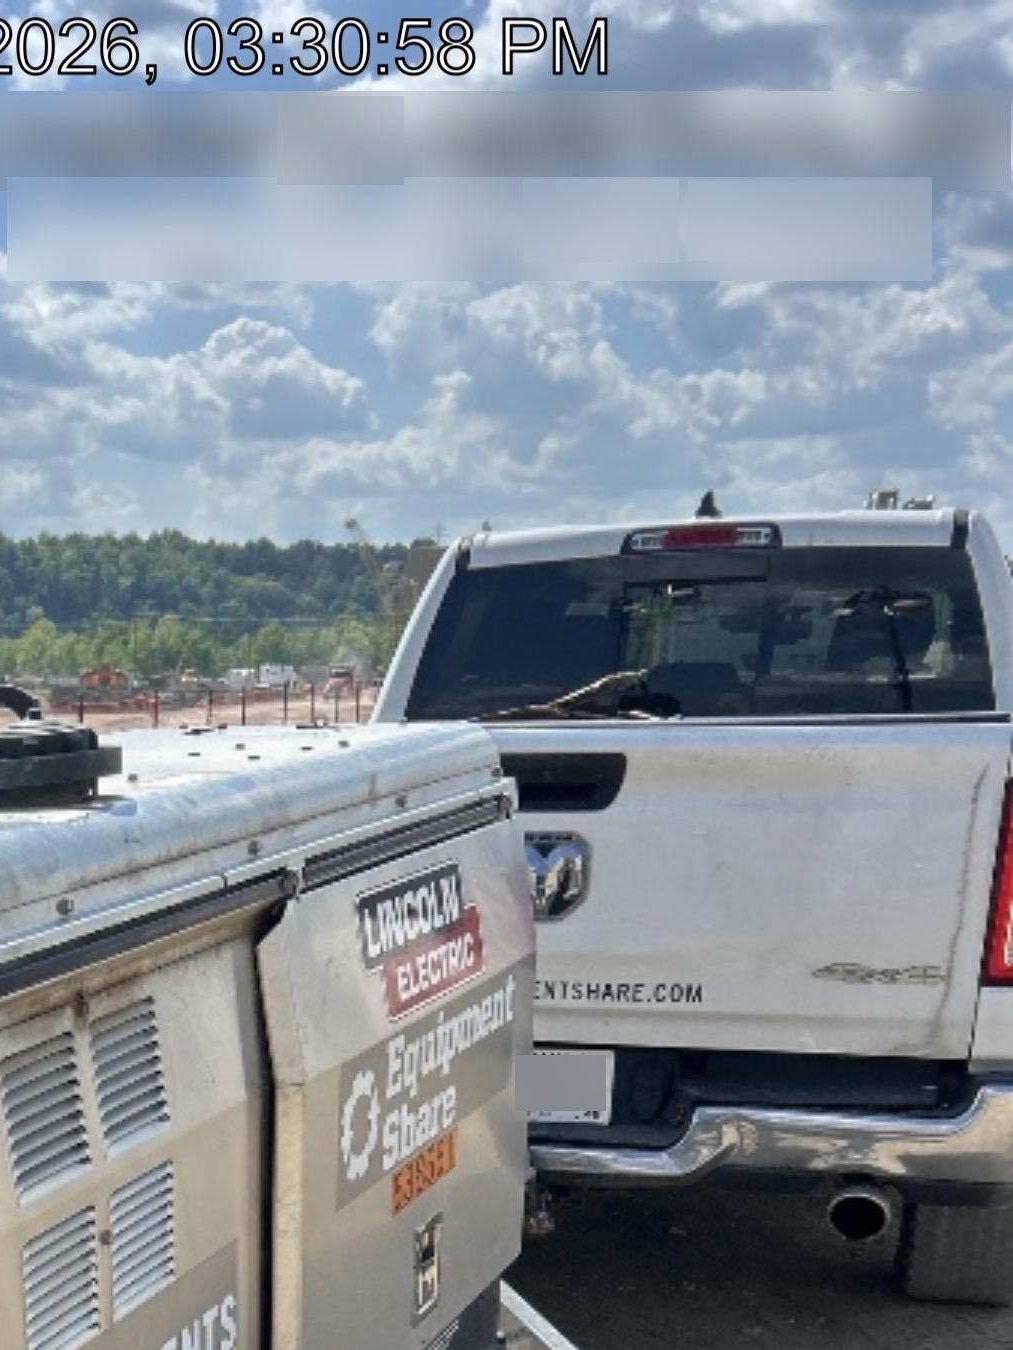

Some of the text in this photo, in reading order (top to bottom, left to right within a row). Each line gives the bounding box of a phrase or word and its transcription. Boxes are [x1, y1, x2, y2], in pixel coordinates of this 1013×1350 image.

[364, 873, 461, 959] LINCOLN
[396, 932, 476, 1003] ELECTRIC
[386, 974, 517, 1100] Equipment
[382, 1085, 458, 1172] Share
